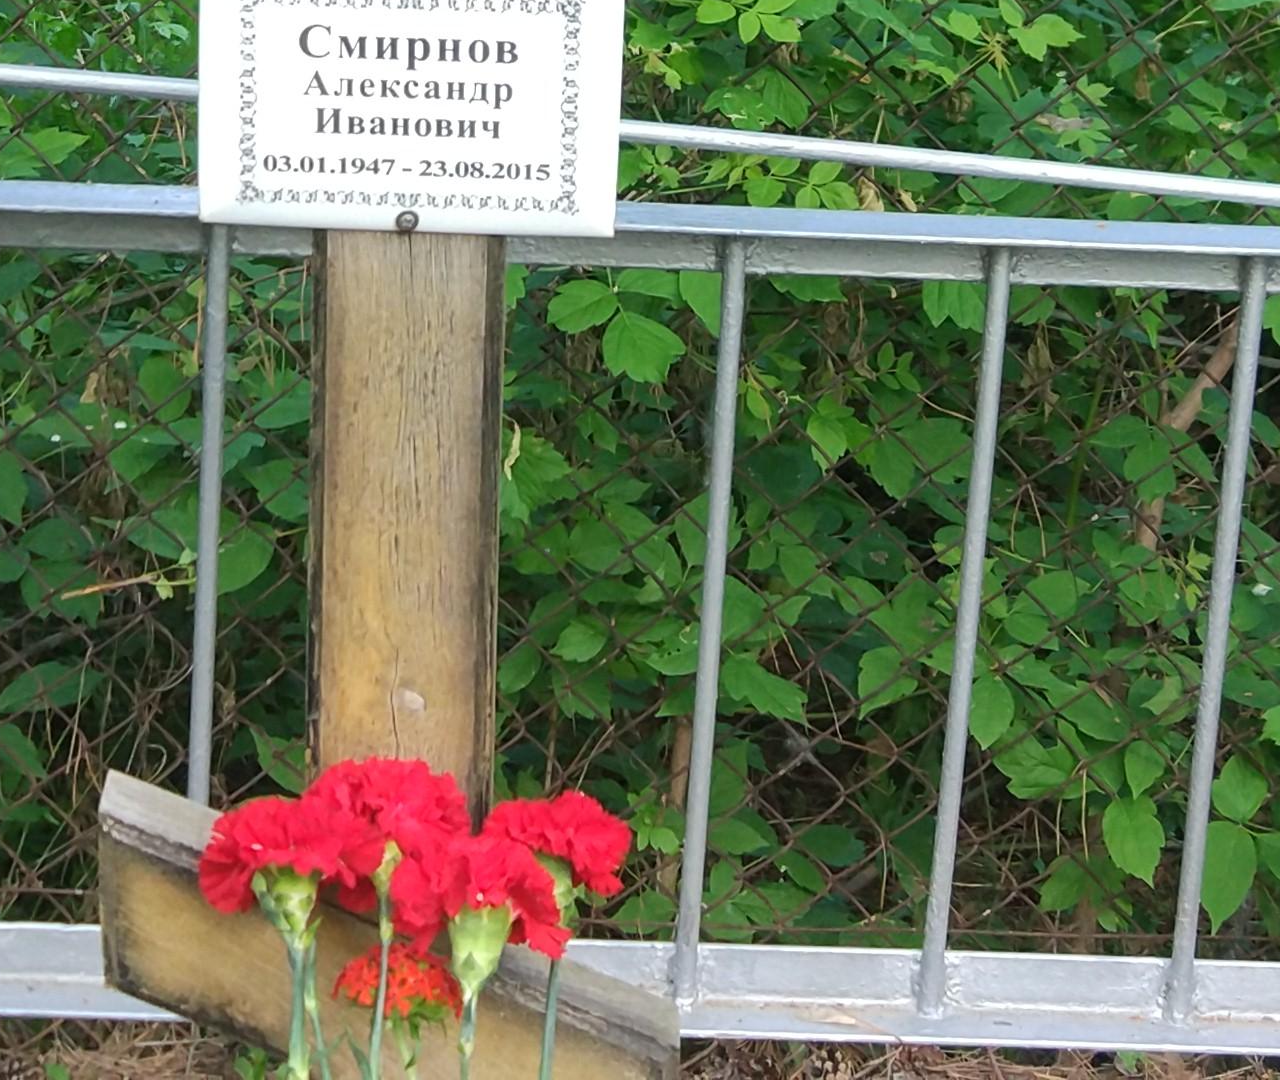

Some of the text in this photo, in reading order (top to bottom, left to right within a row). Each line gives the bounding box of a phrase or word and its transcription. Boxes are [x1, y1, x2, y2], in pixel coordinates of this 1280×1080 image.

[298, 24, 520, 71] Смирнов
[303, 71, 514, 108] Александр
[314, 108, 501, 139] Иванович
[262, 154, 396, 176] 03.01.1947
[419, 160, 551, 181] 23.08.2015
